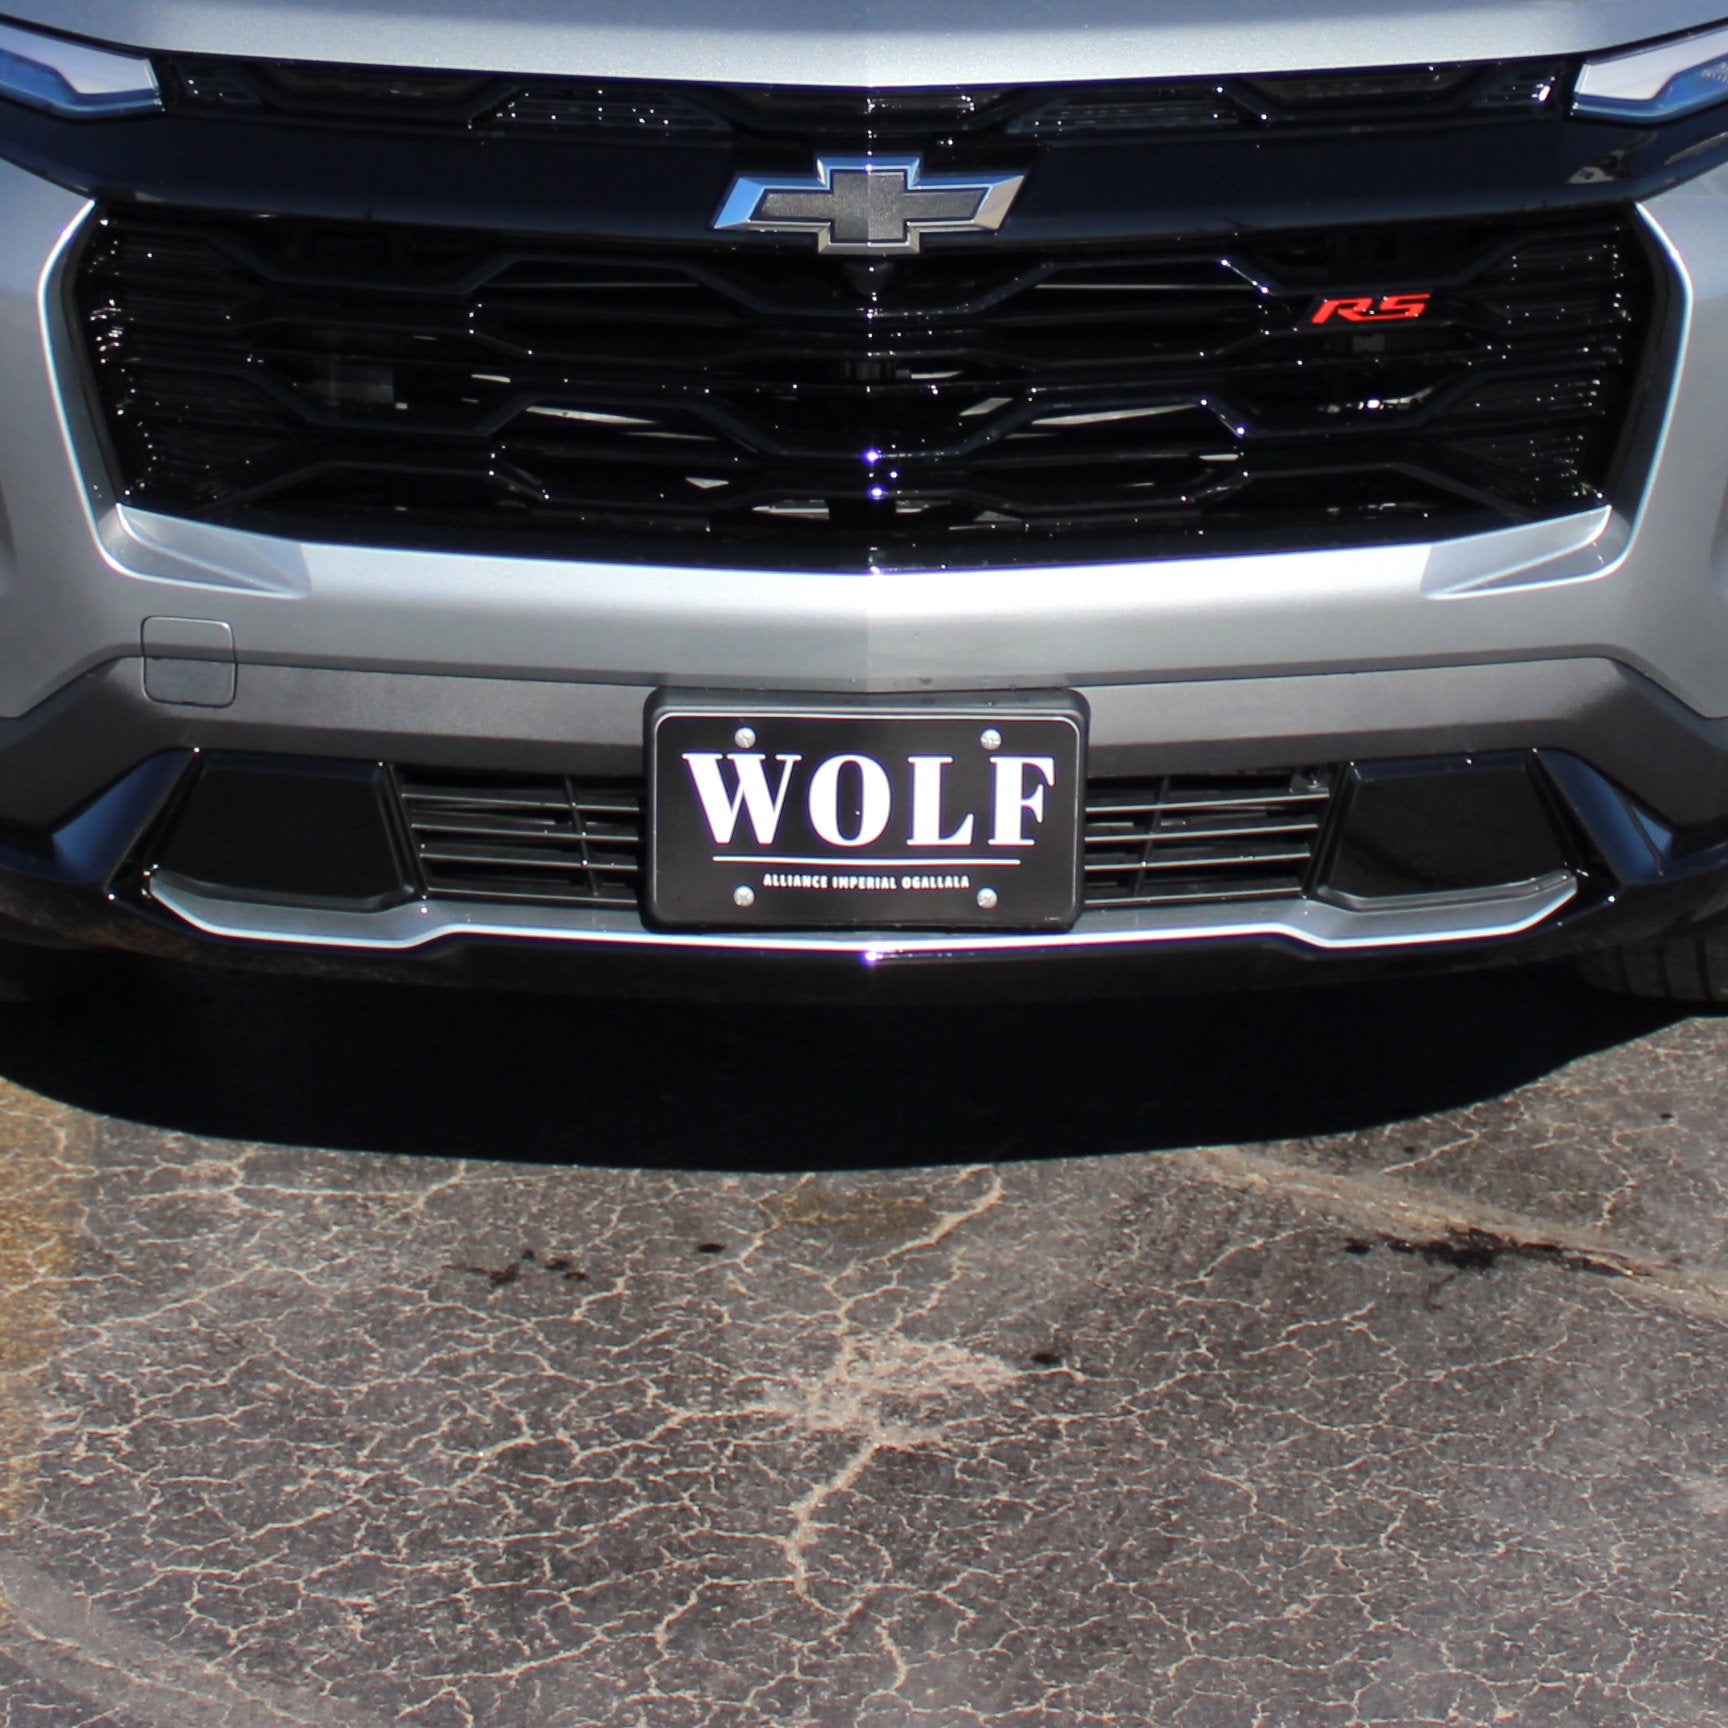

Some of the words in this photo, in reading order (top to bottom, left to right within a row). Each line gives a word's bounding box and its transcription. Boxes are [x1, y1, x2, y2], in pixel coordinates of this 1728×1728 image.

[1311, 293, 1431, 324] RS
[681, 752, 1057, 847] WOLF
[762, 873, 829, 889] ALLIANCE
[832, 875, 898, 891] IMPERIAL
[901, 875, 971, 890] OGALLALA
